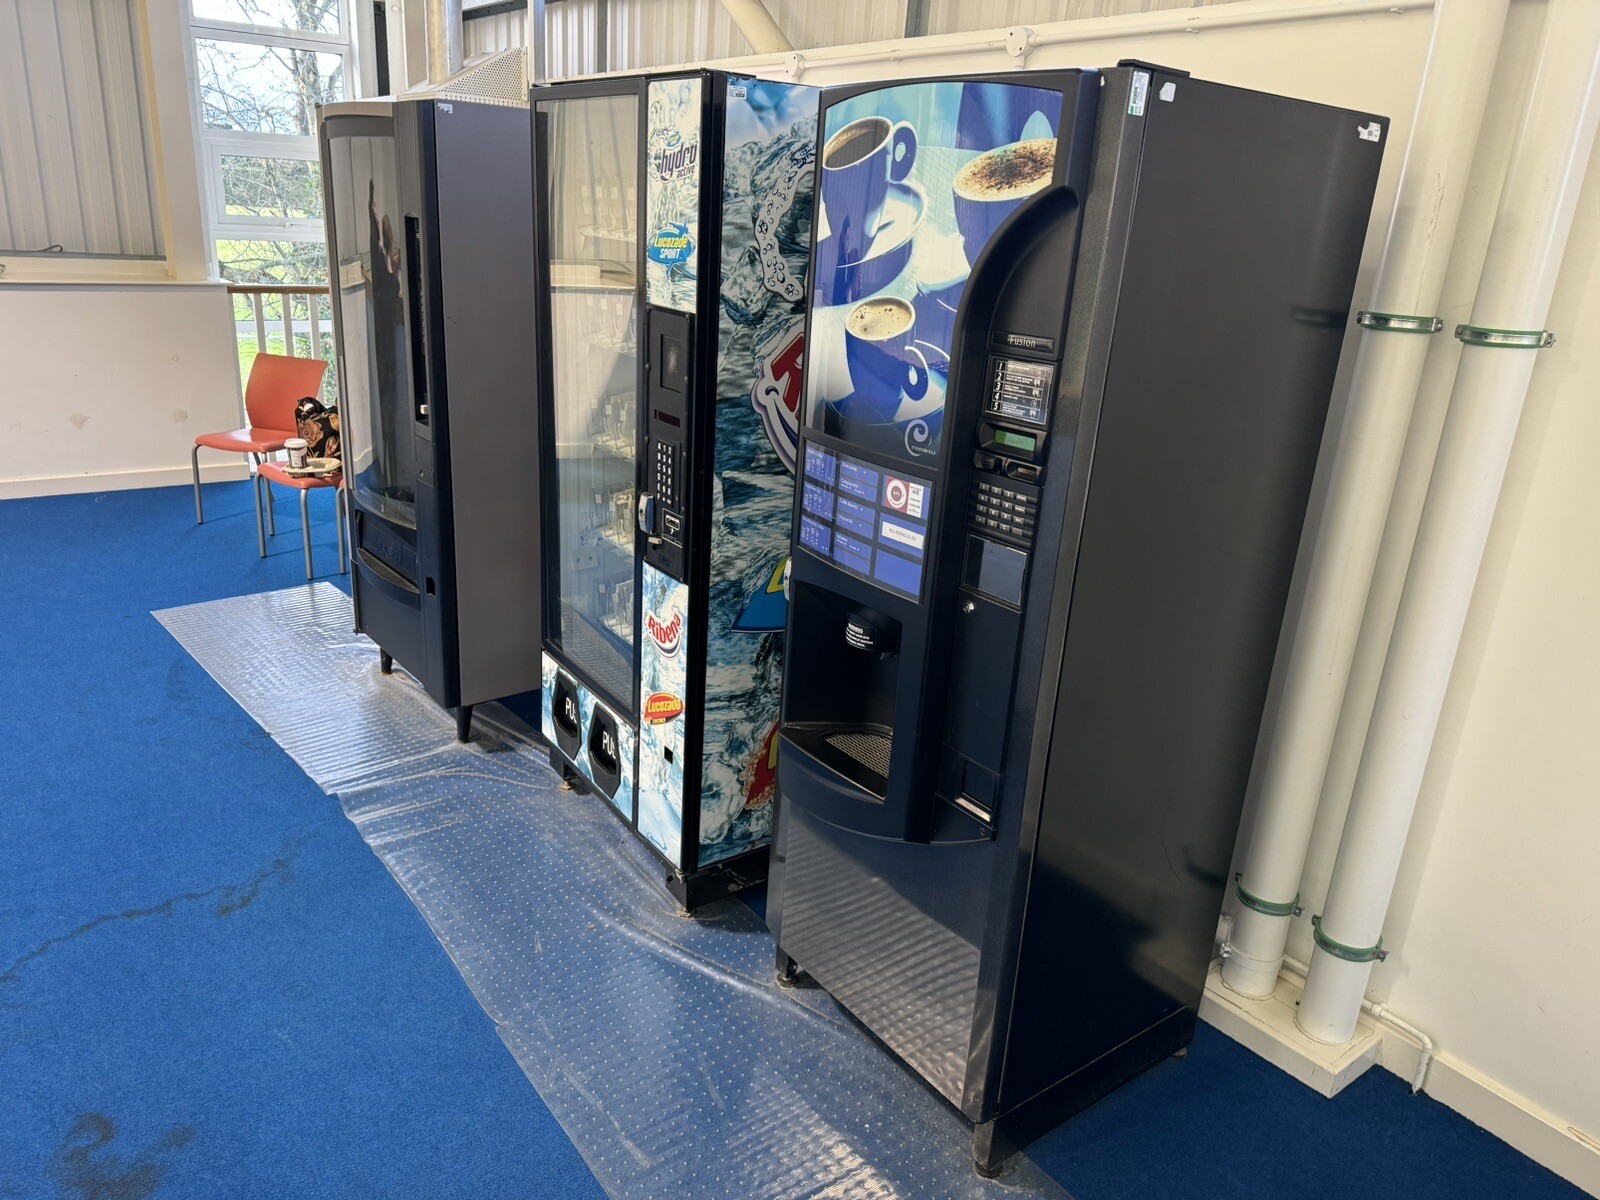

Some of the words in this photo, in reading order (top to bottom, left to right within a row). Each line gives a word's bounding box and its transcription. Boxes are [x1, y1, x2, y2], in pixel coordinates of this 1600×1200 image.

[660, 142, 698, 178] hydro
[654, 234, 688, 248] Lucozade
[659, 248, 682, 259] SPORT
[1009, 334, 1036, 348] Fusion
[997, 372, 1002, 381] 2
[995, 382, 1001, 391] 3
[994, 392, 999, 401] 4
[993, 402, 998, 411] 5
[648, 613, 681, 643] Ribena
[648, 700, 681, 713] Lucozade
